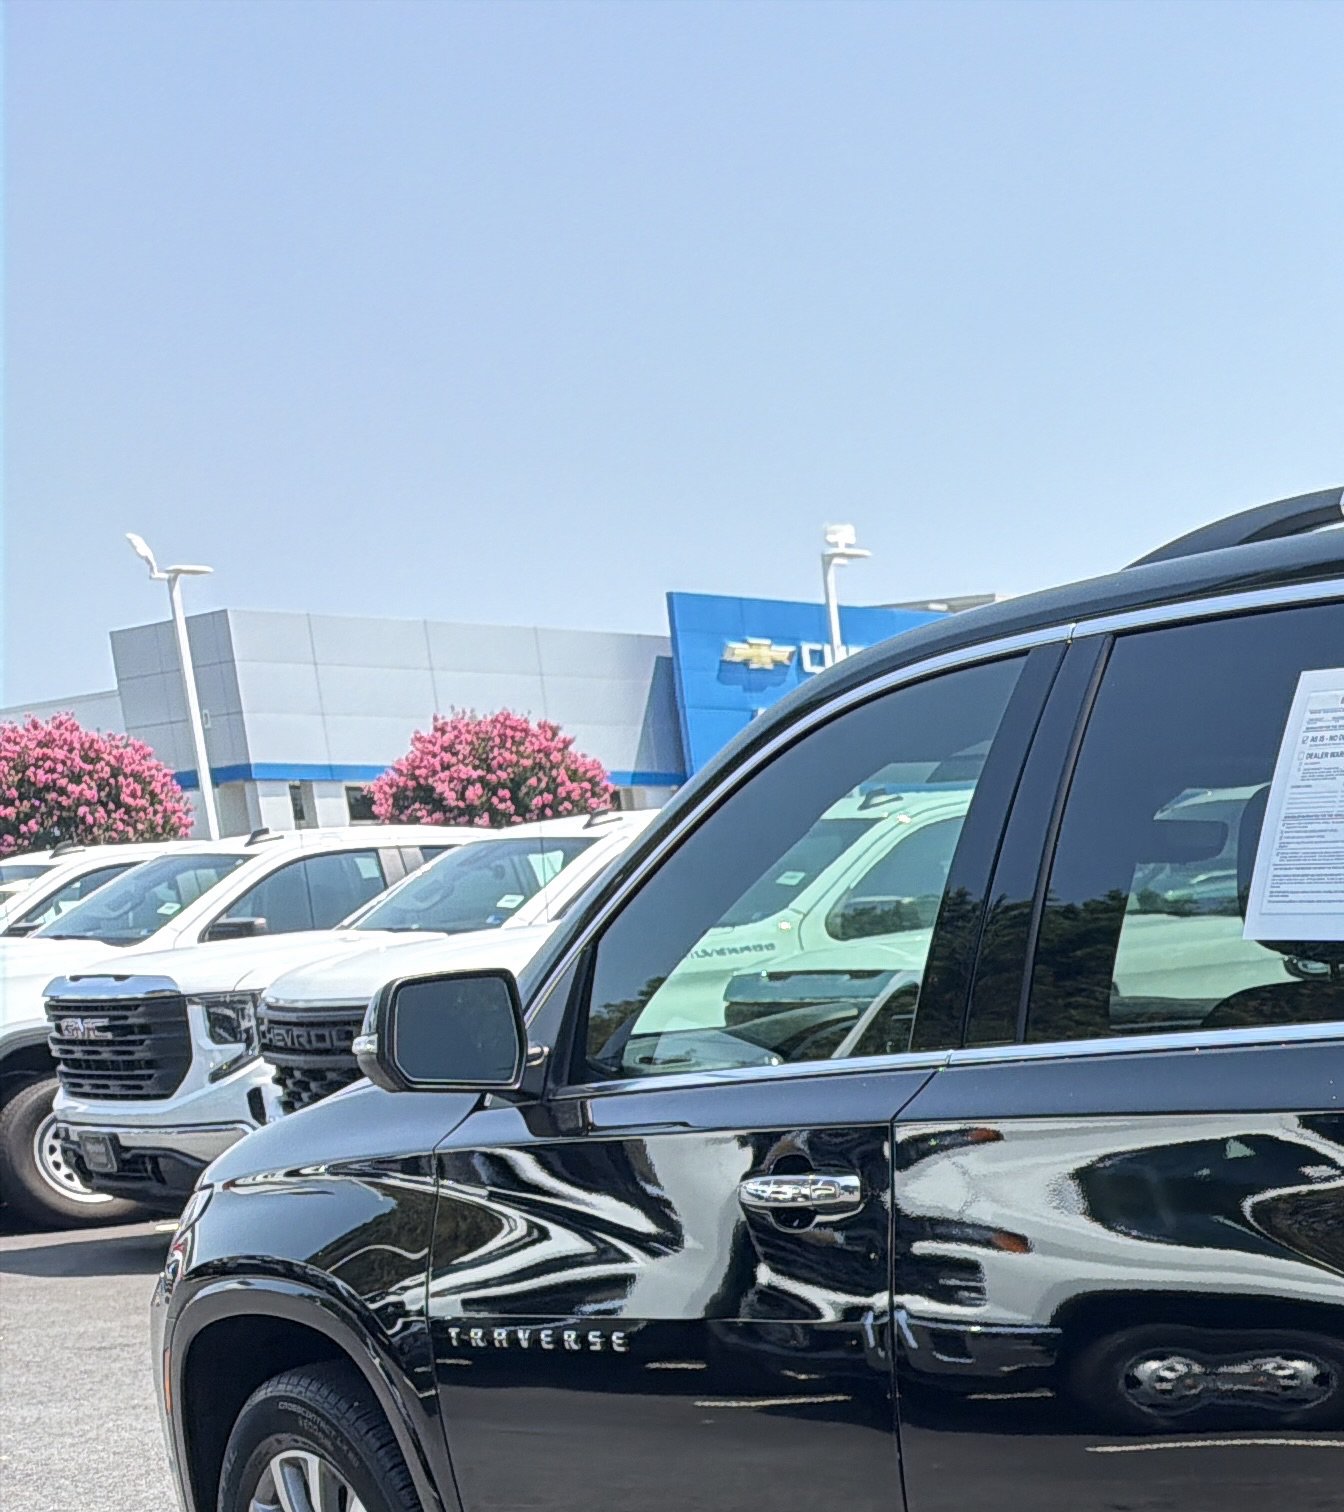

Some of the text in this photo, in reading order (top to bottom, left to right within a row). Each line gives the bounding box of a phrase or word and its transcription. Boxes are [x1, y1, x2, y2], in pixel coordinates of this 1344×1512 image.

[1305, 751, 1328, 760] DEALER
[61, 1018, 113, 1040] GMC
[447, 1326, 629, 1352] TRAVERSE
